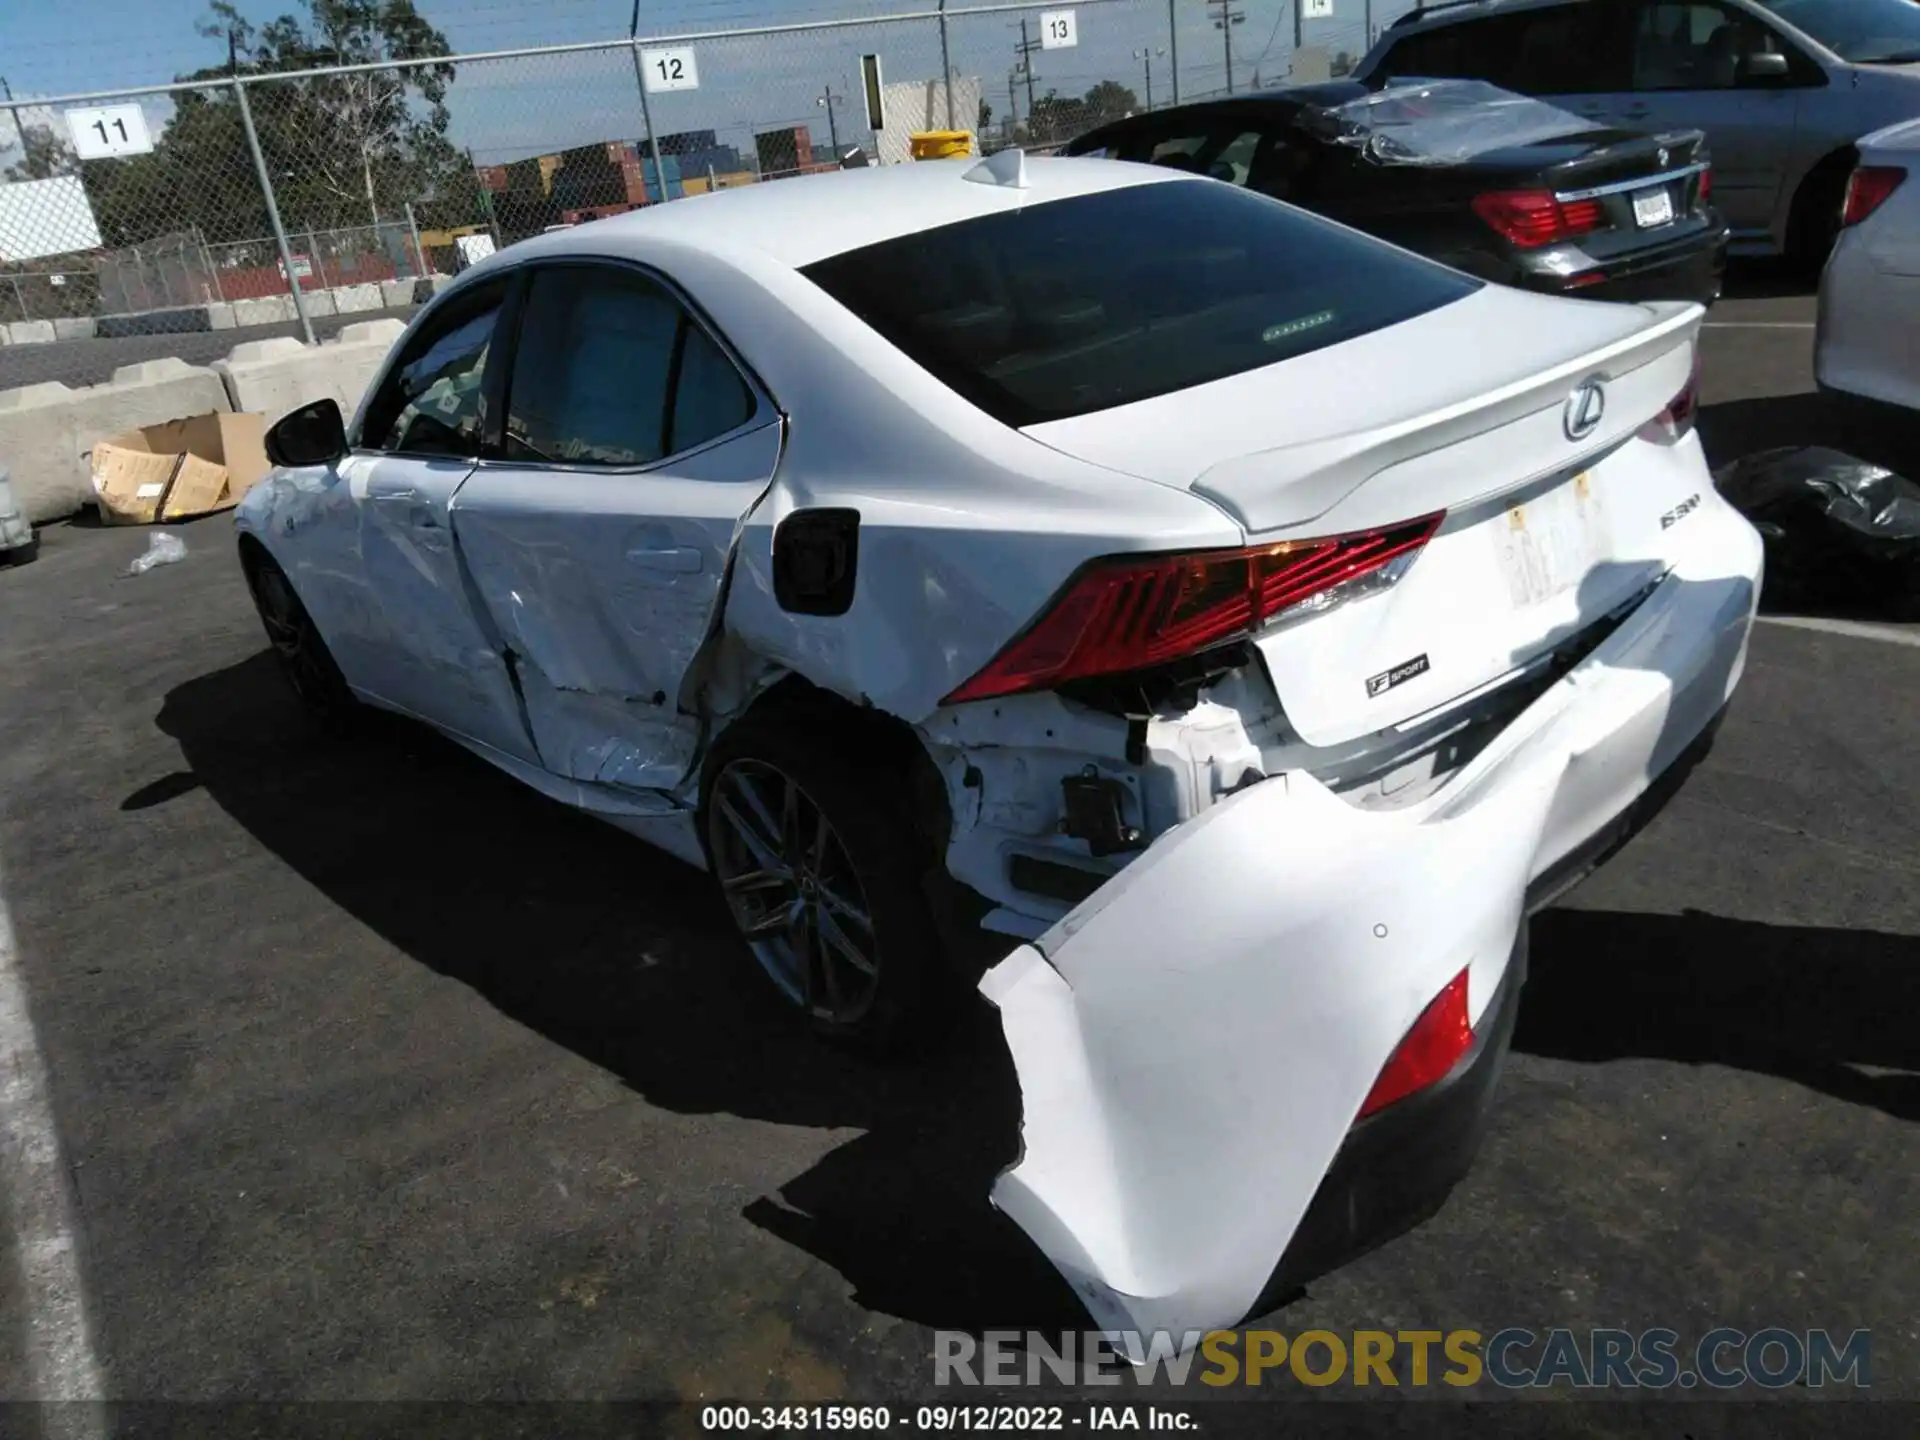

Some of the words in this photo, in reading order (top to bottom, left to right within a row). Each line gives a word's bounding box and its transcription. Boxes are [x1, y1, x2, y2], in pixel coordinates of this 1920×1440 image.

[1050, 20, 1068, 39] 13
[657, 58, 684, 81] 12
[92, 117, 128, 144] 11
[1391, 659, 1426, 682] SPORT
